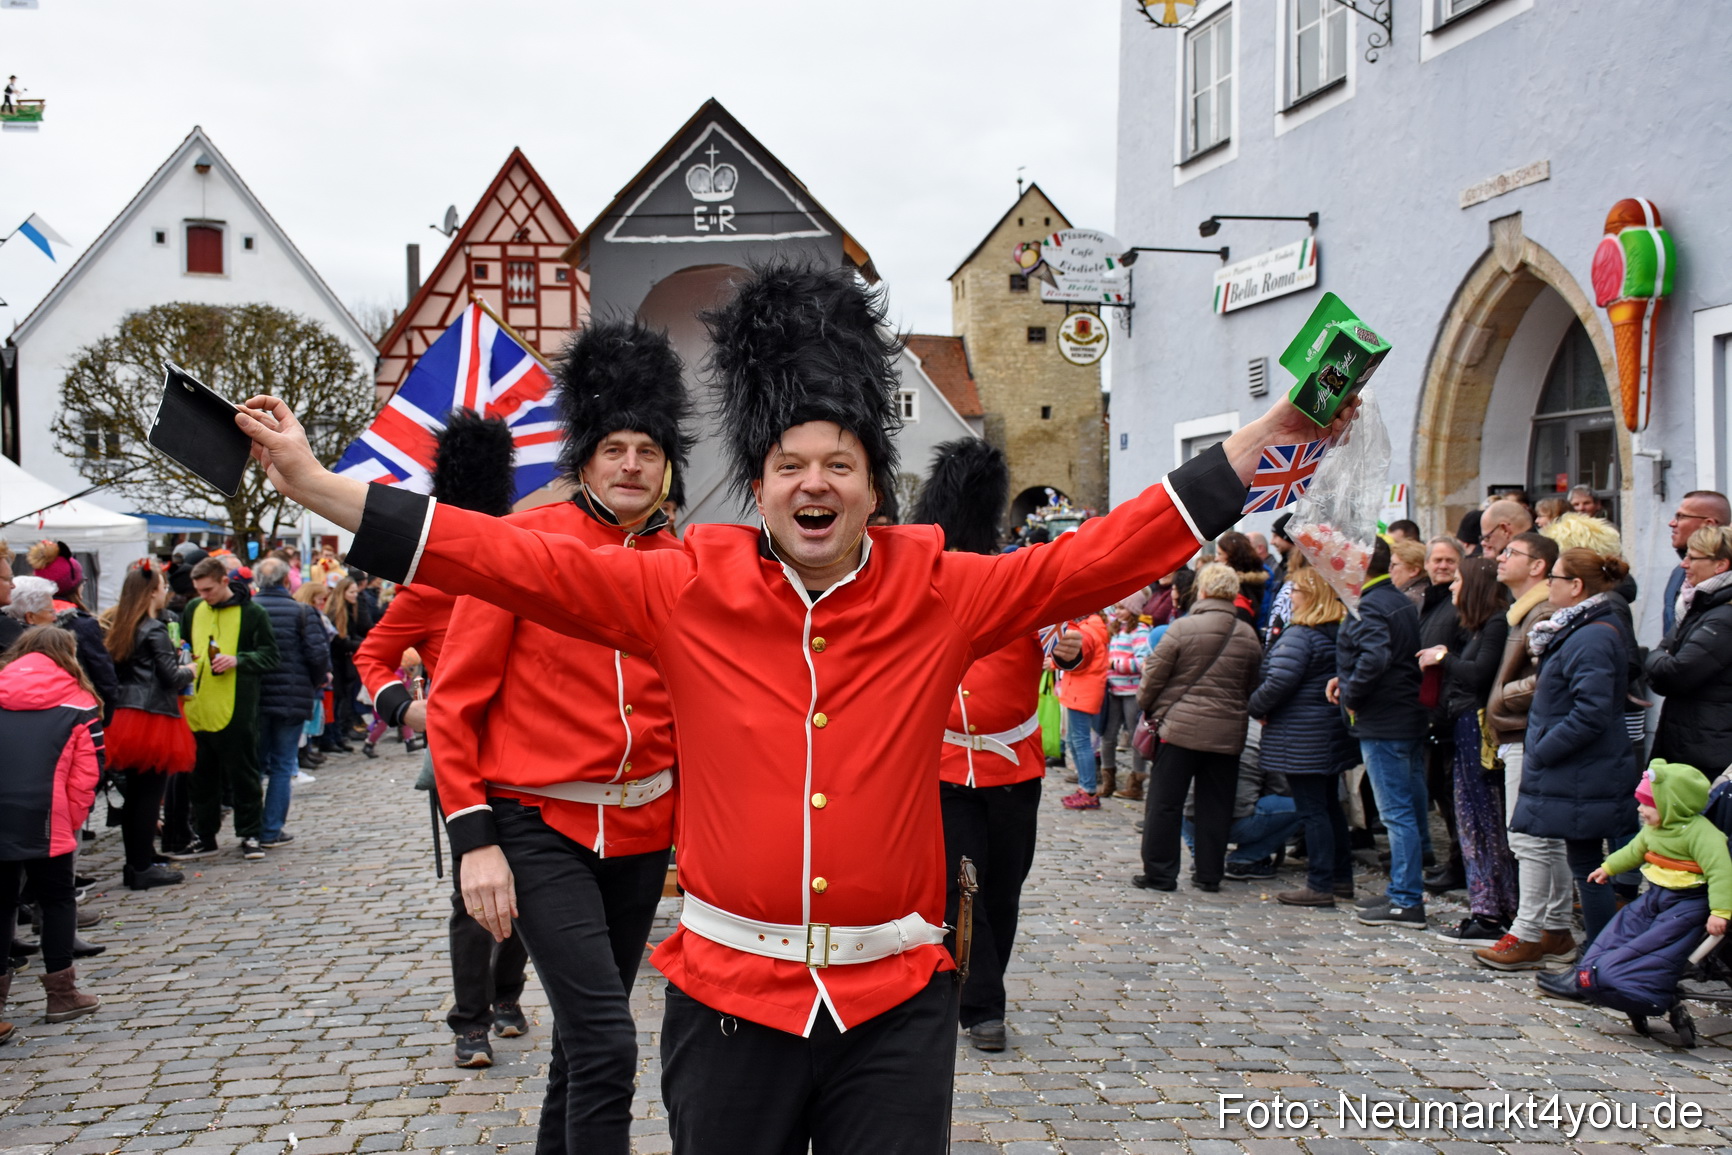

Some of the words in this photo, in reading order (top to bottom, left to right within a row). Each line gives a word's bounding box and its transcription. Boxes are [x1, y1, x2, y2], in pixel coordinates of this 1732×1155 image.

[1060, 232, 1104, 244] Pizzeria
[1070, 247, 1094, 259] Café
[1059, 260, 1104, 274] Eisdiele
[1229, 278, 1258, 304] Bella
[1261, 272, 1296, 294] Roma
[1333, 349, 1357, 377] Eight
